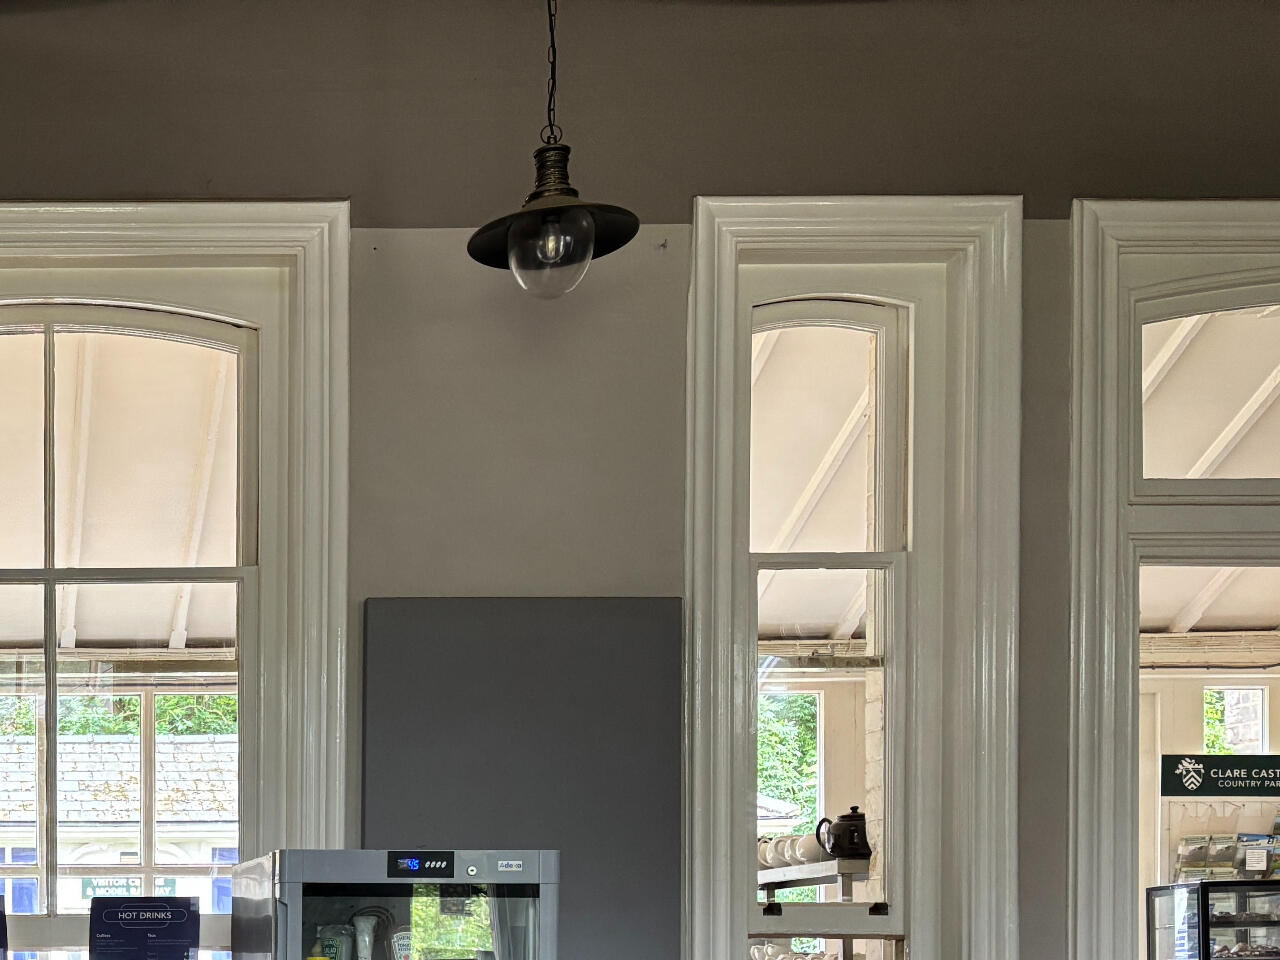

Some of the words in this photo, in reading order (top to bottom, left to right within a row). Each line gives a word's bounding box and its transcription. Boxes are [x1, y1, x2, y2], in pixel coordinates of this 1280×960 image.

[1210, 769, 1248, 778] CLARE
[1218, 780, 1261, 788] COUNTRY
[92, 878, 127, 886] VISITOR
[118, 911, 137, 919] HOT
[140, 911, 172, 919] DRINKS
